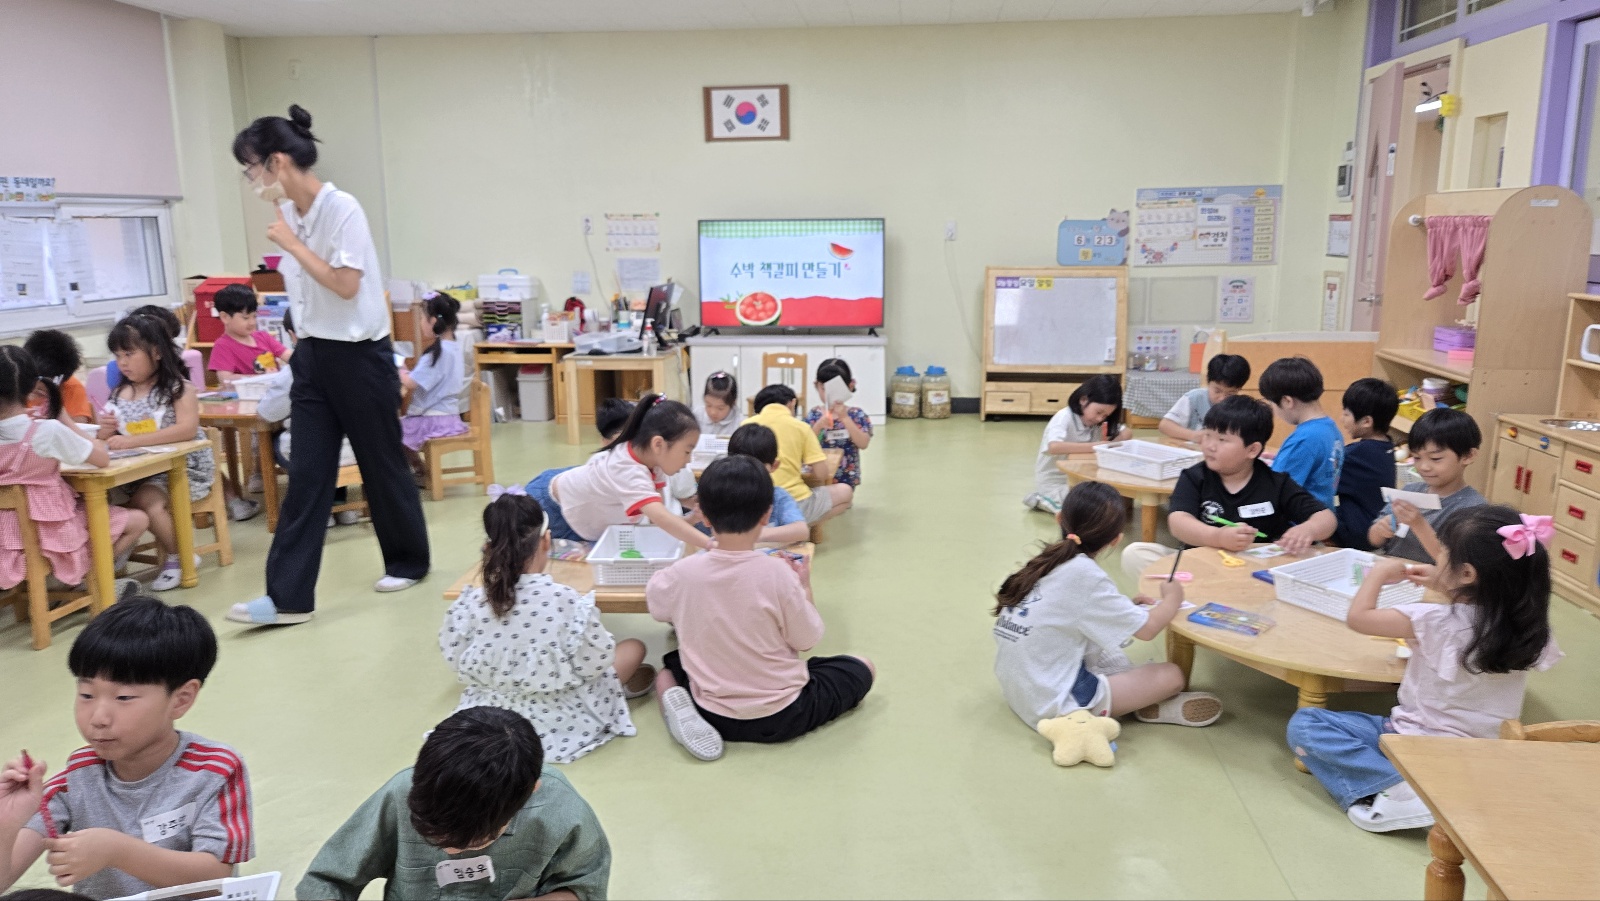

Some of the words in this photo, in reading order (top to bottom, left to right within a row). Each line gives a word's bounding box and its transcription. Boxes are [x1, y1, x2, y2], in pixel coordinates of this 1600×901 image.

[13, 176, 55, 188] 동네일까요?
[1076, 236, 1083, 244] 6
[1096, 236, 1114, 245] 23
[1211, 231, 1228, 242] 경청
[730, 262, 755, 279] 수박
[760, 261, 799, 279] 책갈피
[802, 261, 842, 279] 만들기
